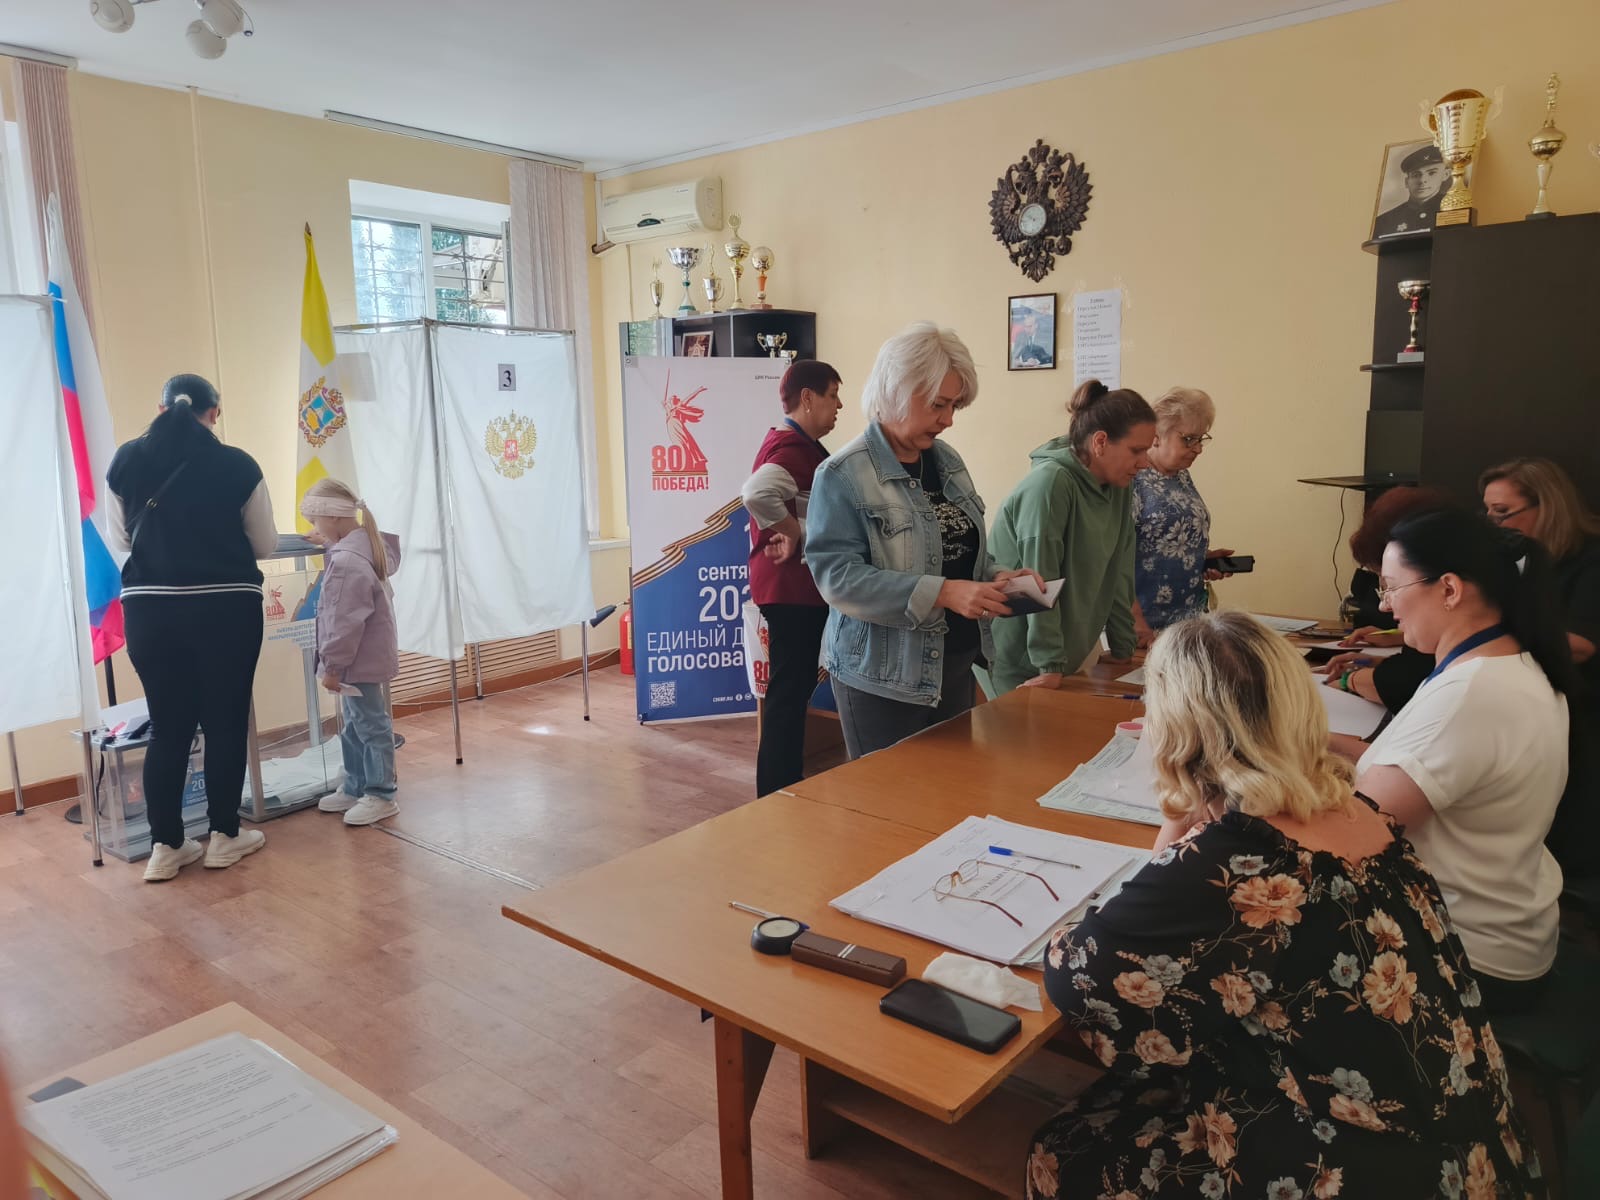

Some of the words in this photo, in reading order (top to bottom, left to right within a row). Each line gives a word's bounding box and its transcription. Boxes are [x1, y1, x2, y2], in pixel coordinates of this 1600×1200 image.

[503, 370, 512, 387] 3
[651, 445, 682, 471] 80
[652, 477, 709, 492] ПОБЕДА!
[698, 565, 751, 581] сентя
[647, 623, 726, 653] ЕДИНЫЙ
